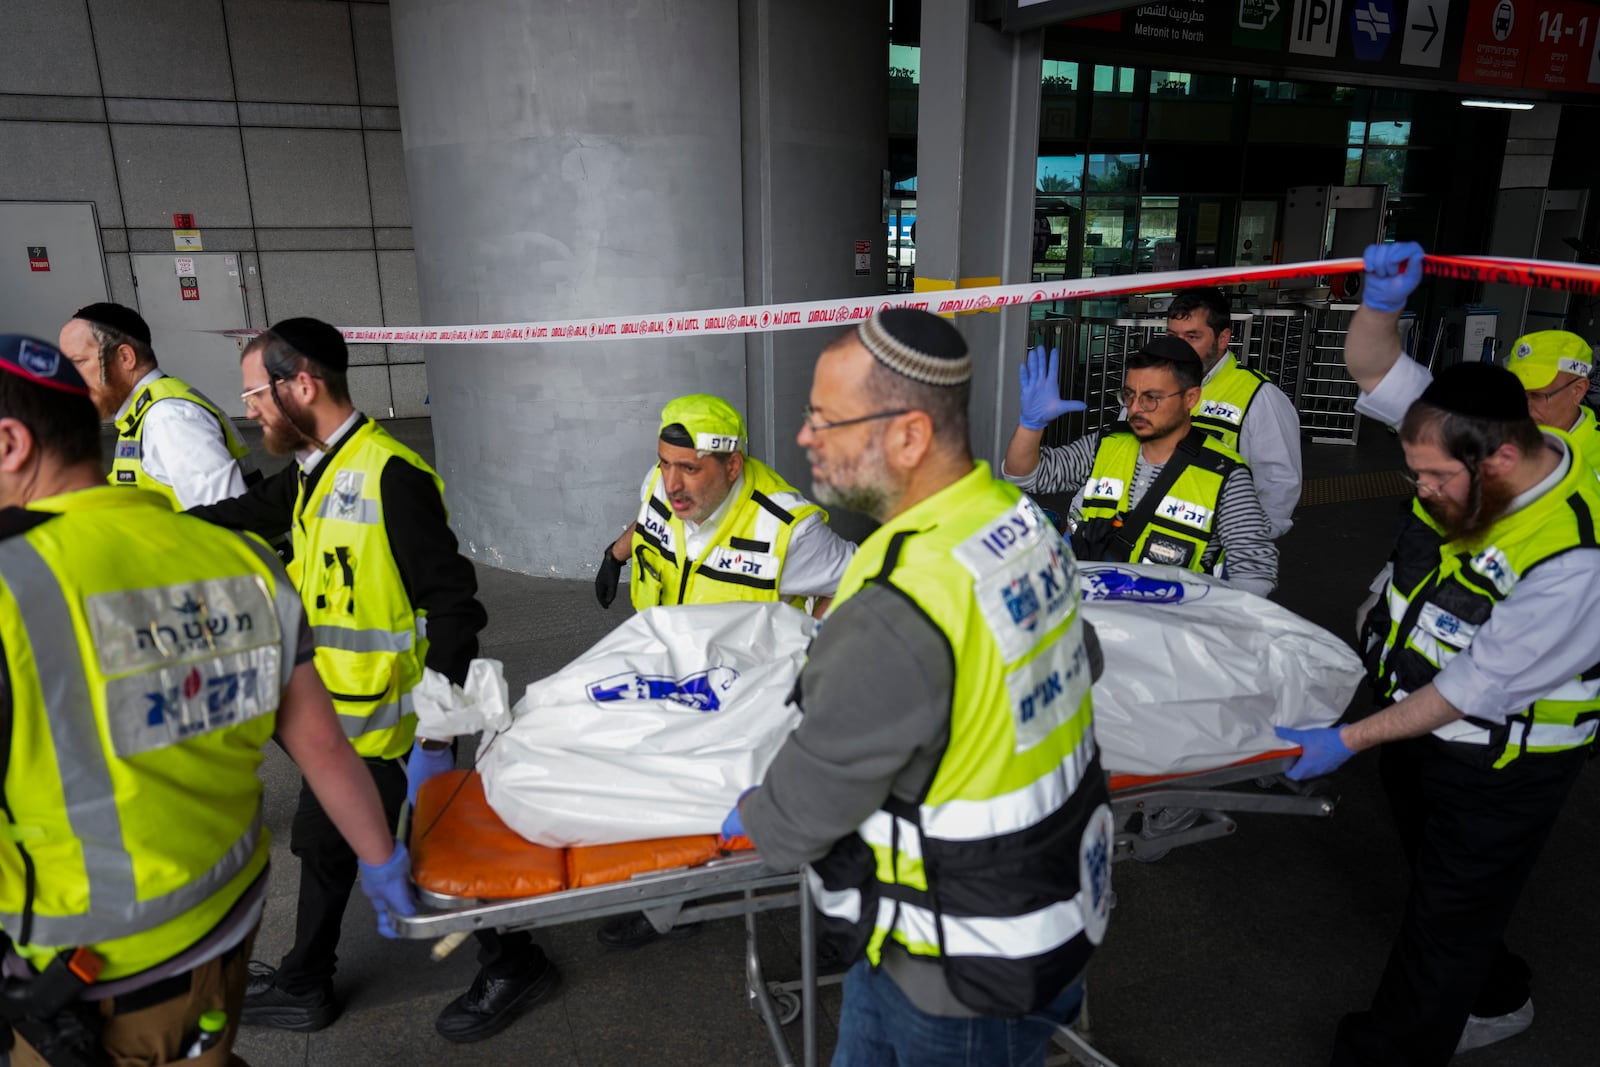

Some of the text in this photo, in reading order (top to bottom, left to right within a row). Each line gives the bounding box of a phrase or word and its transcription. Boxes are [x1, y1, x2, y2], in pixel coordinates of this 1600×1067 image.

[1134, 23, 1204, 42] Metronit to North
[183, 289, 198, 298] אש
[135, 611, 253, 651] משטרה
